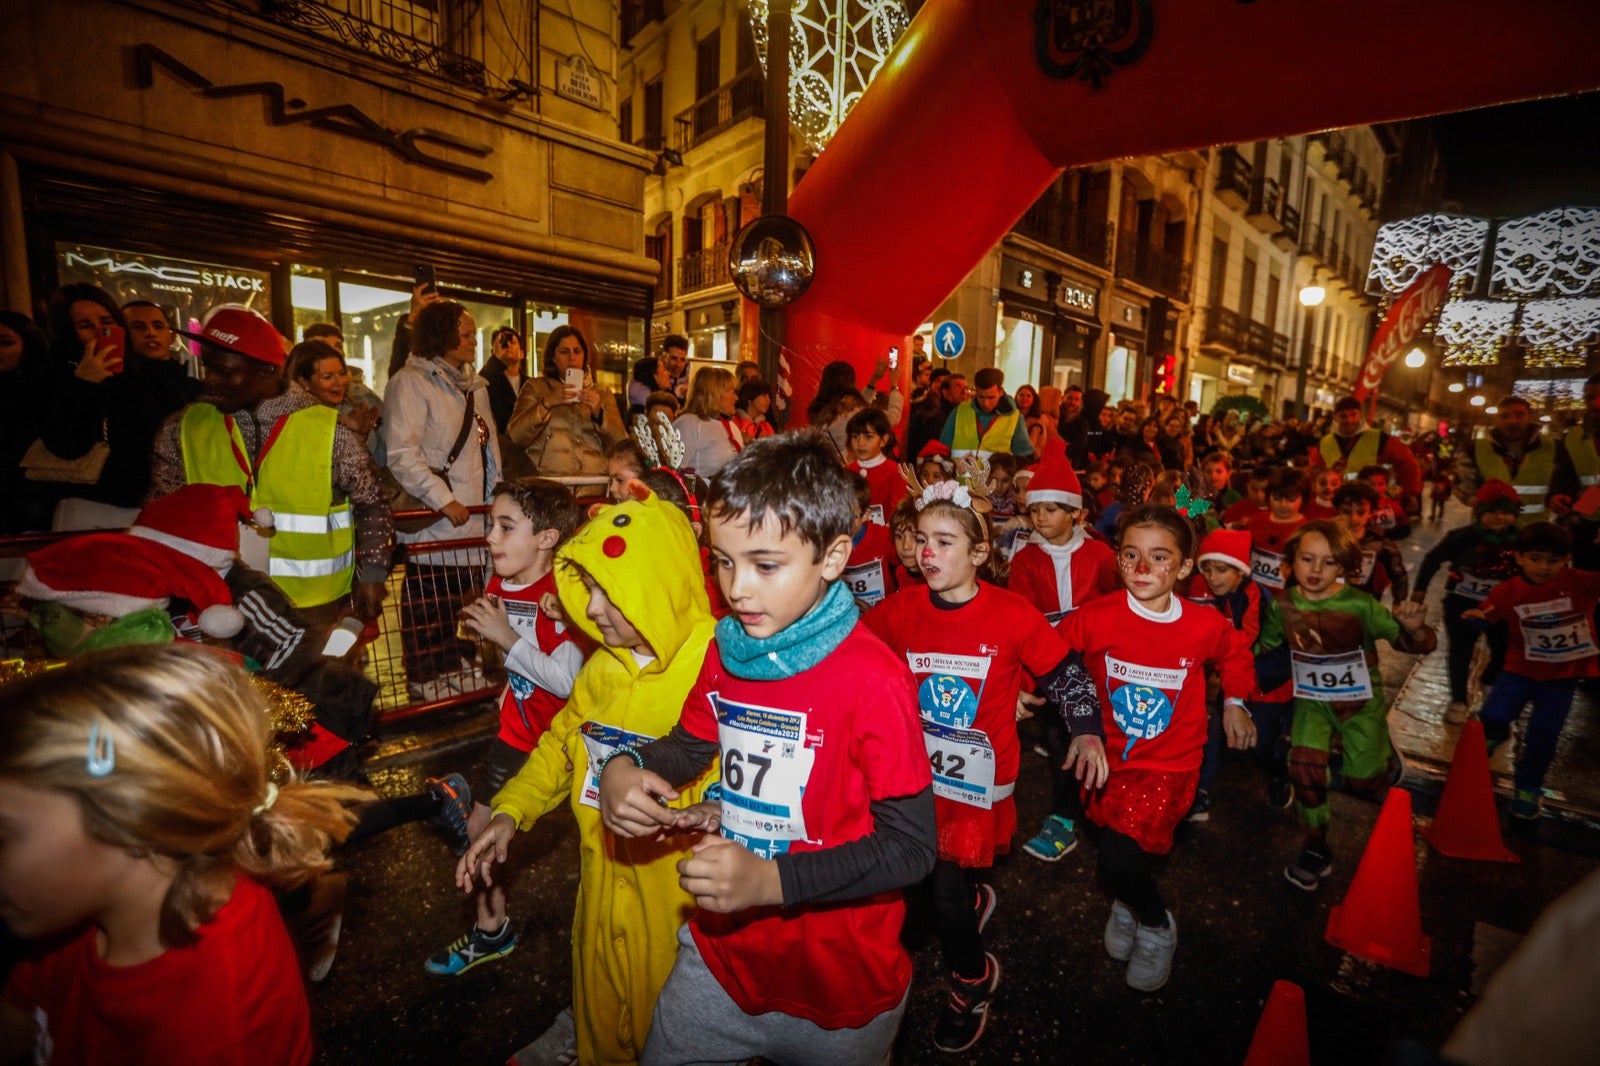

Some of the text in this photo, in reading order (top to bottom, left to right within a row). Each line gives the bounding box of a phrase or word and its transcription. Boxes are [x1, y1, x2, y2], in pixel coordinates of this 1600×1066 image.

[152, 283, 193, 294] MASCARA
[202, 272, 264, 293] STACK
[212, 327, 240, 346] neff
[1253, 560, 1281, 578] 204
[1537, 630, 1580, 649] 321
[915, 656, 931, 669] 30
[1113, 662, 1127, 676] 30
[1306, 671, 1356, 688] 194
[729, 719, 799, 739] #NocturnaGranada2022
